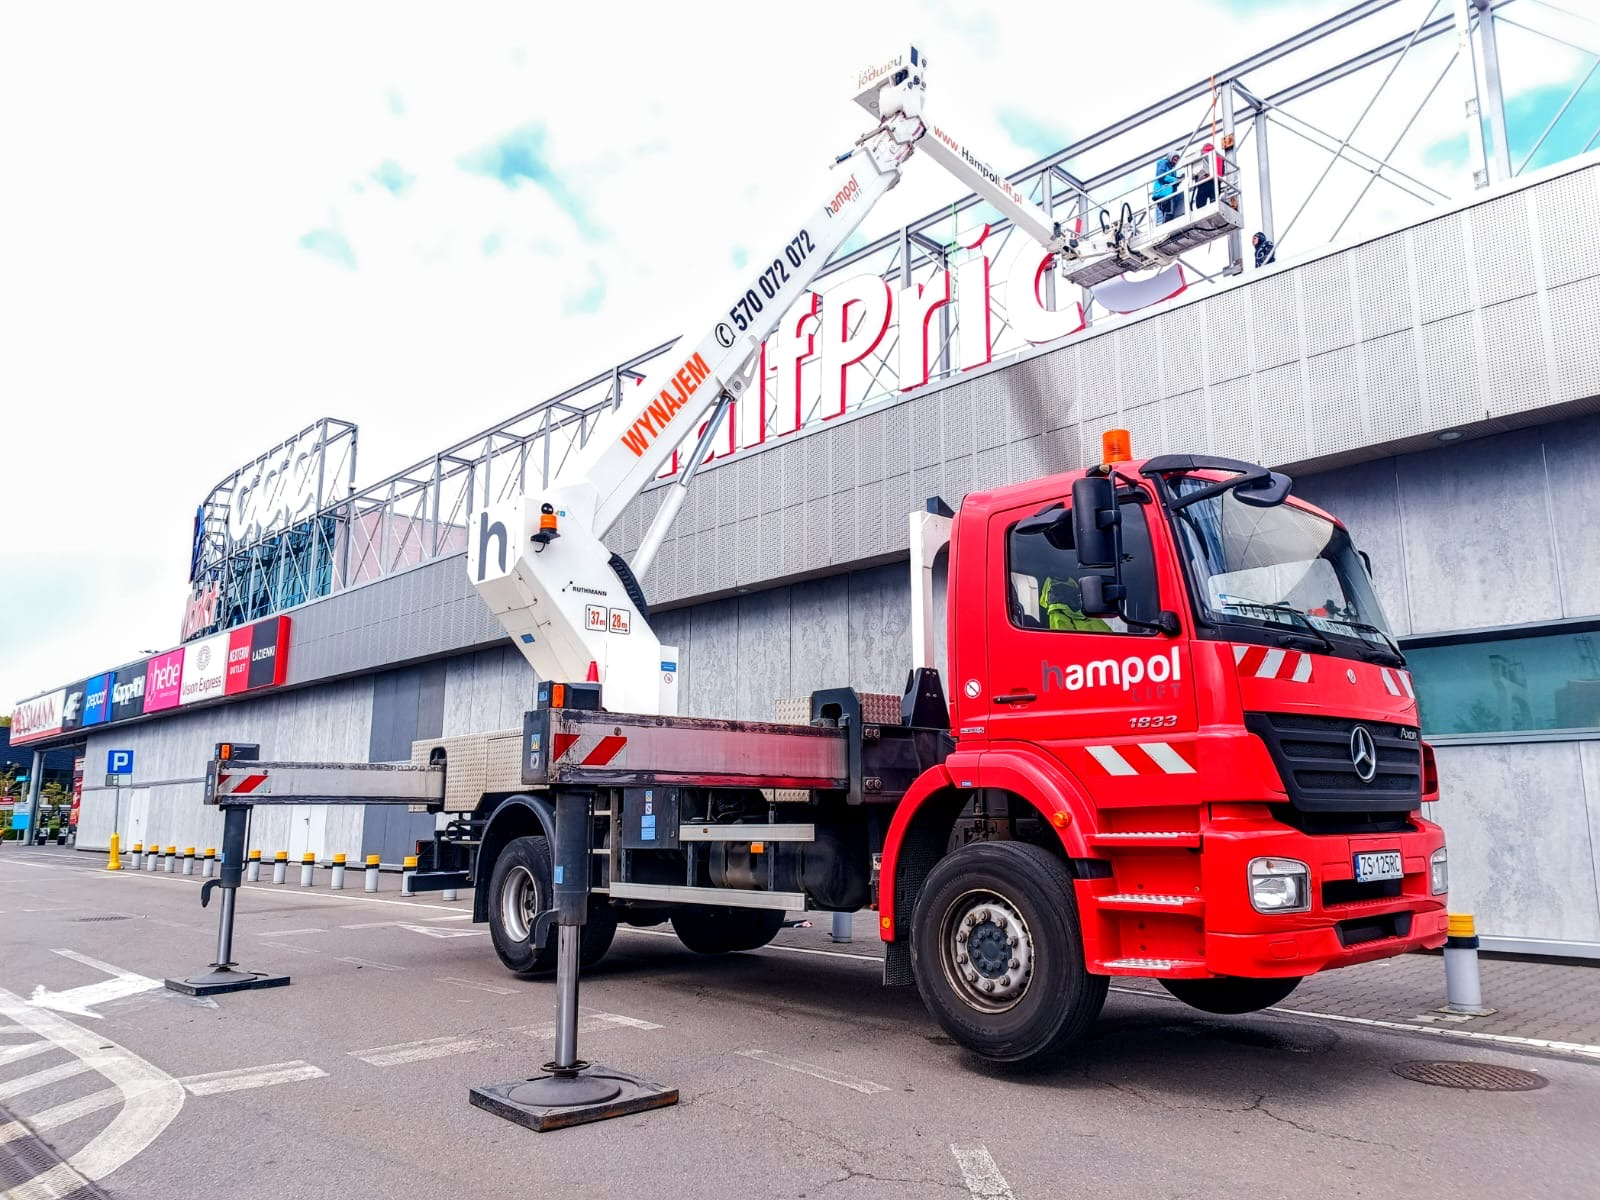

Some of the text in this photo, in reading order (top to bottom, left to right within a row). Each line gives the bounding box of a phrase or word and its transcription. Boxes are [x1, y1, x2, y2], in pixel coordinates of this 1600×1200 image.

[824, 173, 859, 218] hampol
[729, 229, 816, 331] 570 072 072
[620, 351, 712, 458] WYNAJEM
[572, 586, 607, 597] RUTHMANN
[152, 658, 180, 692] hebe
[229, 663, 246, 675] OUTLET
[1042, 646, 1181, 692] hampol
[182, 682, 199, 697] Vision
[199, 675, 222, 693] Express
[1132, 684, 1181, 702] LIFT
[1128, 715, 1178, 729] 1833
[113, 752, 129, 772] P
[1361, 854, 1400, 875] ZS 125RC
